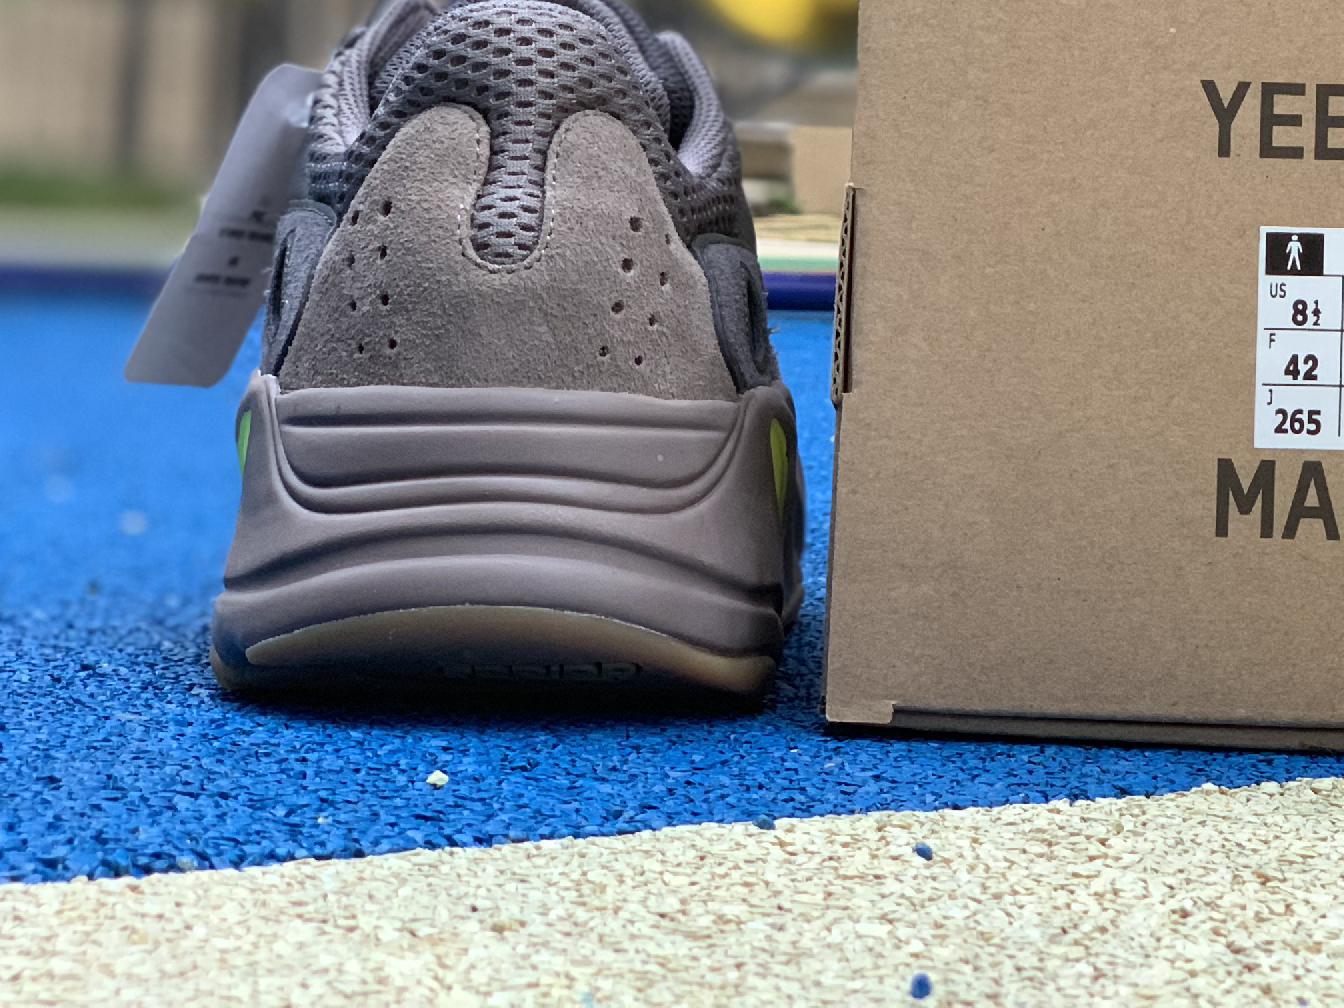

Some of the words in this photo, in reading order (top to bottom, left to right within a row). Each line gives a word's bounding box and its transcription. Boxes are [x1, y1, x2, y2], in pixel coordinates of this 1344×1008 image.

[1269, 282, 1287, 299] US
[1268, 332, 1277, 349] F
[1283, 353, 1319, 381] 42
[1266, 389, 1274, 406] J
[1273, 407, 1322, 436] 265
